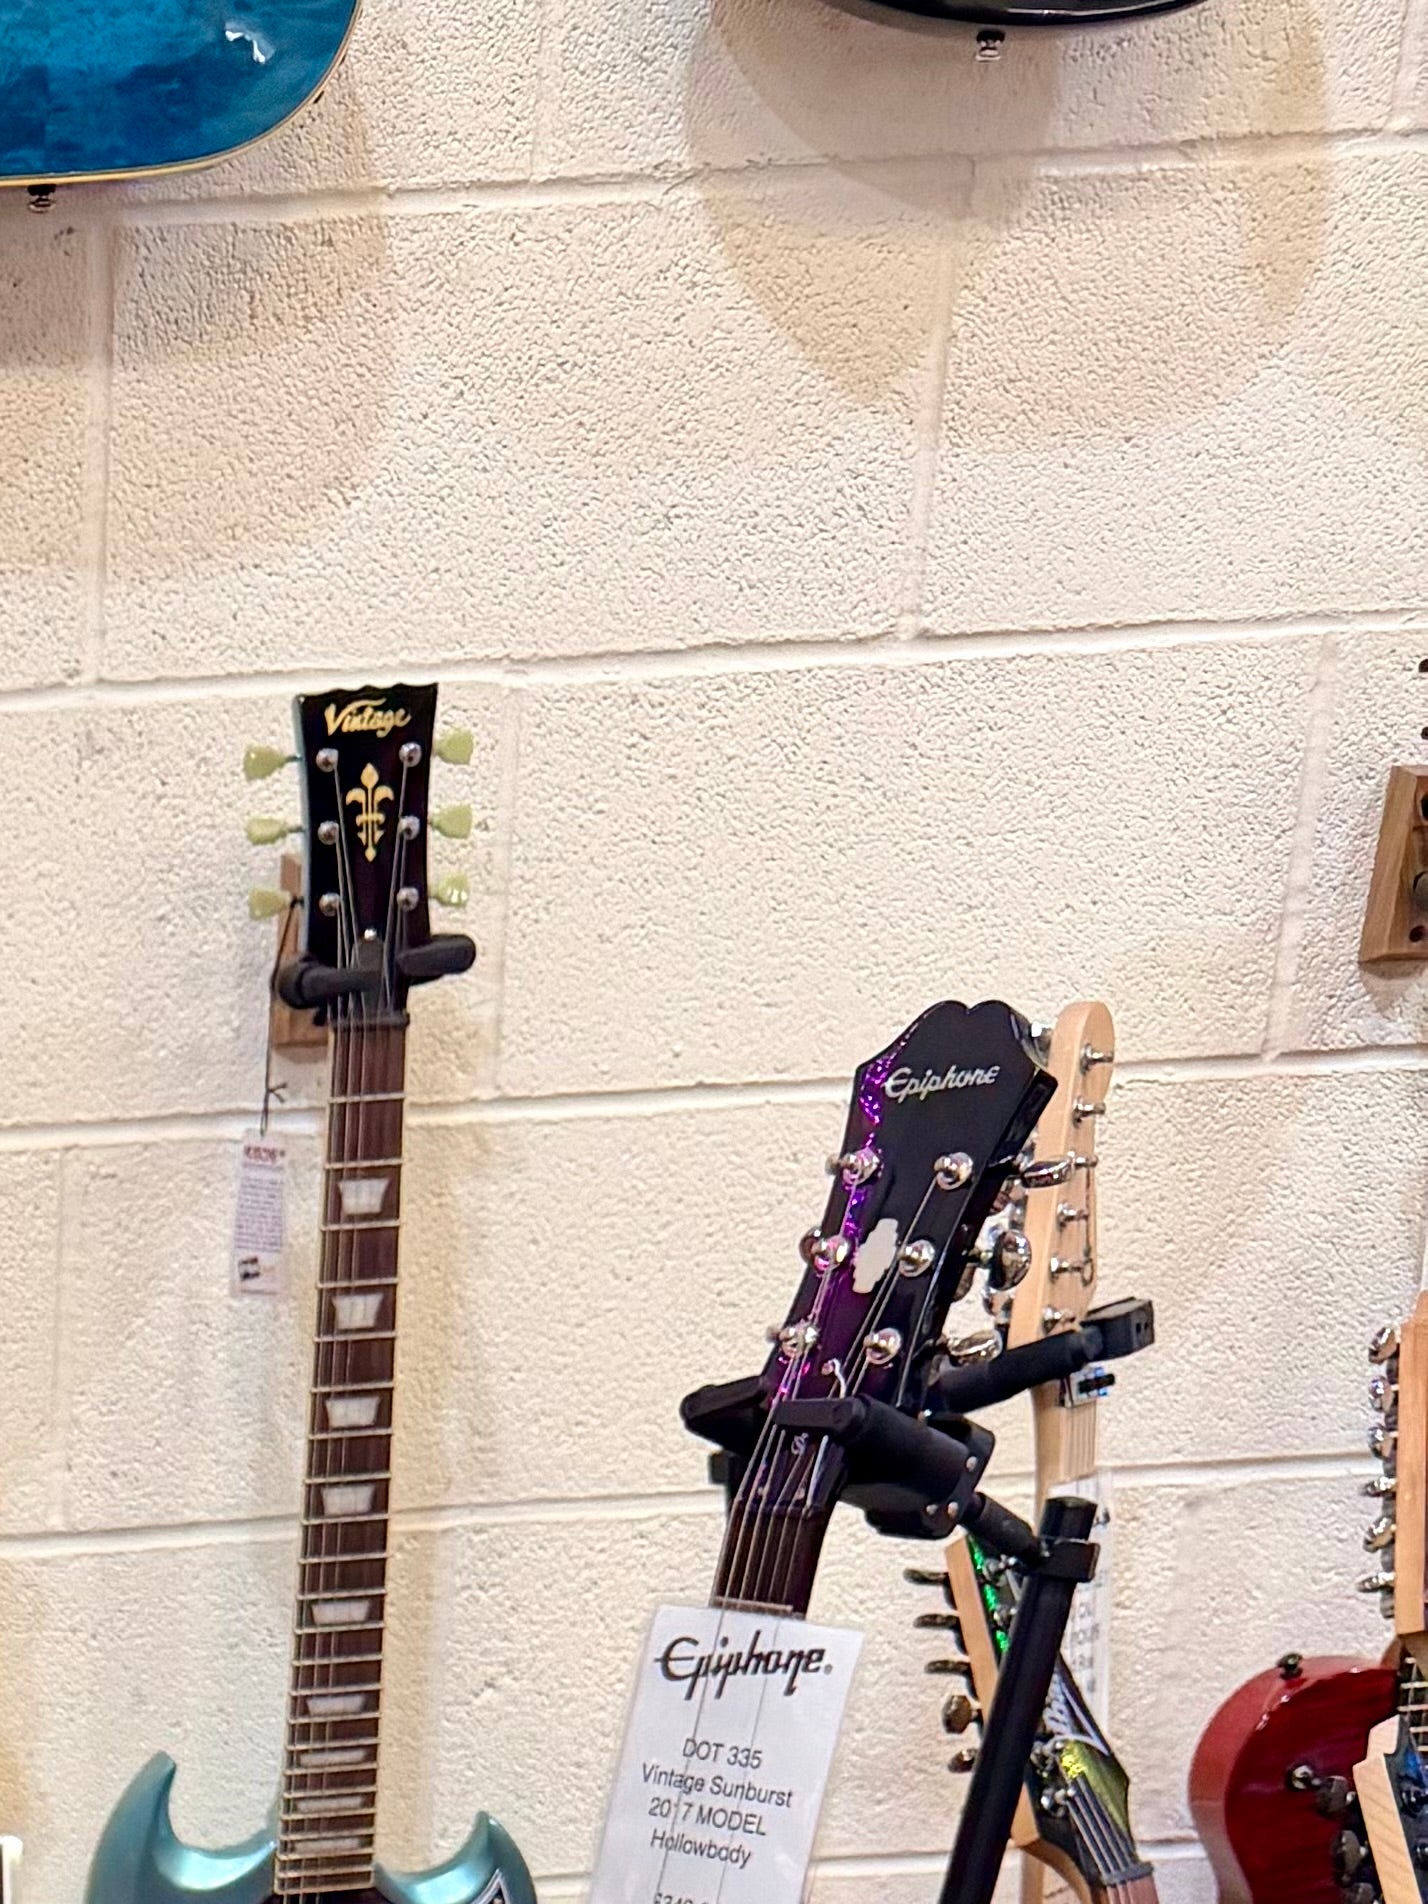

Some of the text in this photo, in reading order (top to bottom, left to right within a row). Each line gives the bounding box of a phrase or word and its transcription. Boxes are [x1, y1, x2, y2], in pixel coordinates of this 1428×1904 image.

[324, 698, 412, 738] Vintage
[881, 1064, 1001, 1104] Epiphone
[682, 1738, 763, 1769] DOT 335
[642, 1763, 793, 1808] Vintage Sunburst
[695, 1807, 767, 1836] MODEL
[650, 1829, 752, 1869] Hollowbody
